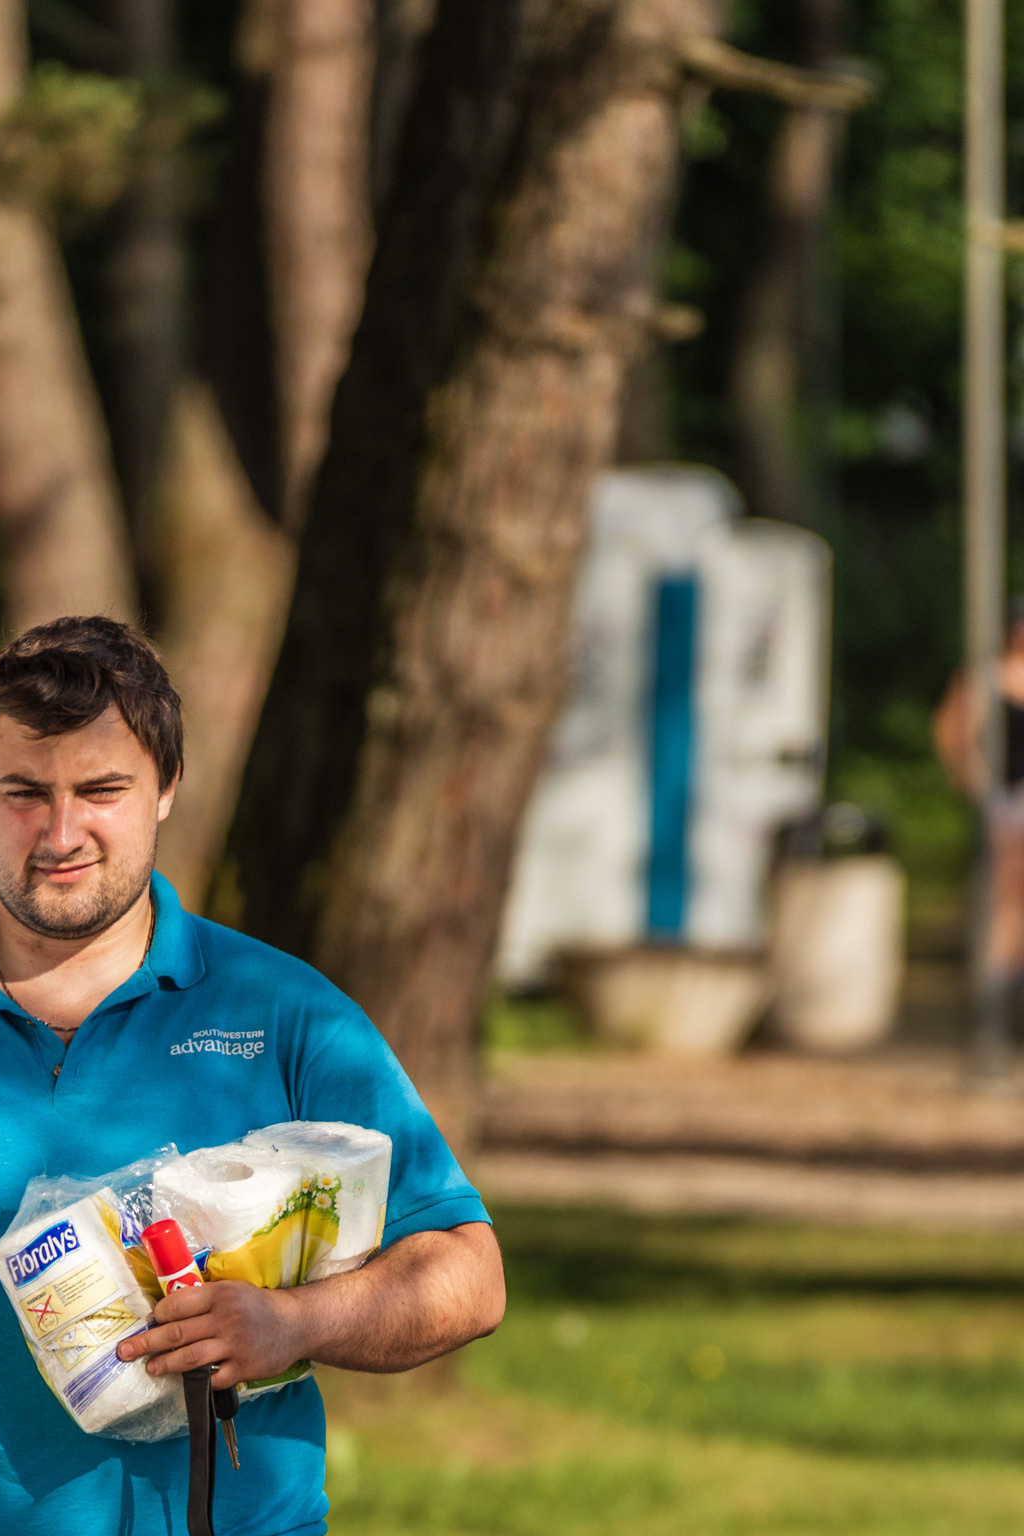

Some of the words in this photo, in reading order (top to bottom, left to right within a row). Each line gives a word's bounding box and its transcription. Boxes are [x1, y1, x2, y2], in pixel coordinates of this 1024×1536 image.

[192, 1028, 265, 1040] SOUTHWESTERN
[170, 1038, 265, 1060] advantage
[8, 1226, 78, 1282] Floralys
